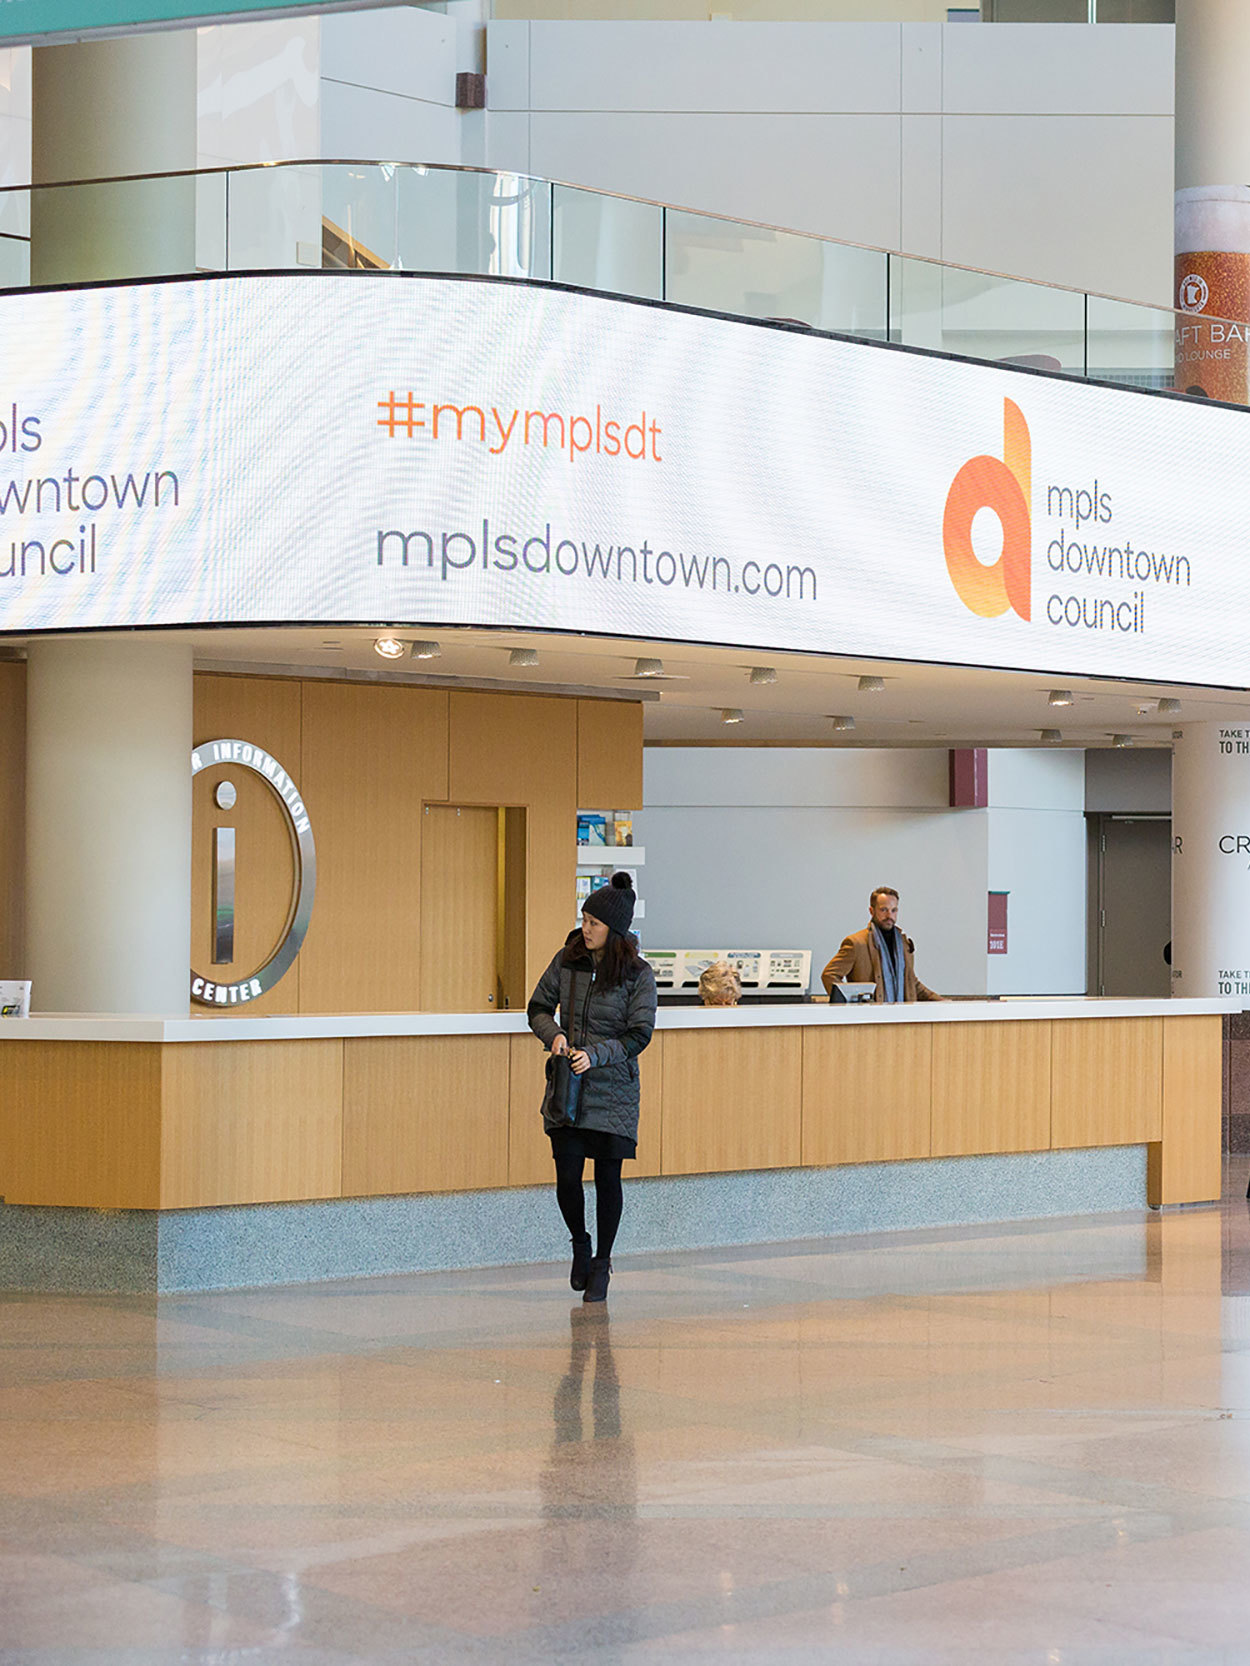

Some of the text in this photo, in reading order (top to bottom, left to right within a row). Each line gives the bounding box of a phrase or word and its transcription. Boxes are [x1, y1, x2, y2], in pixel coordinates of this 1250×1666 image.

[1186, 348, 1231, 362] LOUNGE
[377, 391, 662, 462] #mymplsdt
[1048, 479, 1112, 530] mpls
[377, 518, 817, 601] mplsdowntown.com
[1047, 528, 1190, 586] downtown
[1047, 591, 1144, 633] council
[1219, 730, 1242, 738] TAKE
[1219, 741, 1232, 754] TO
[213, 742, 310, 834] INFORMATION
[192, 978, 262, 1003] CENTER
[1218, 970, 1241, 979] TAKE
[1218, 982, 1231, 994] TO
